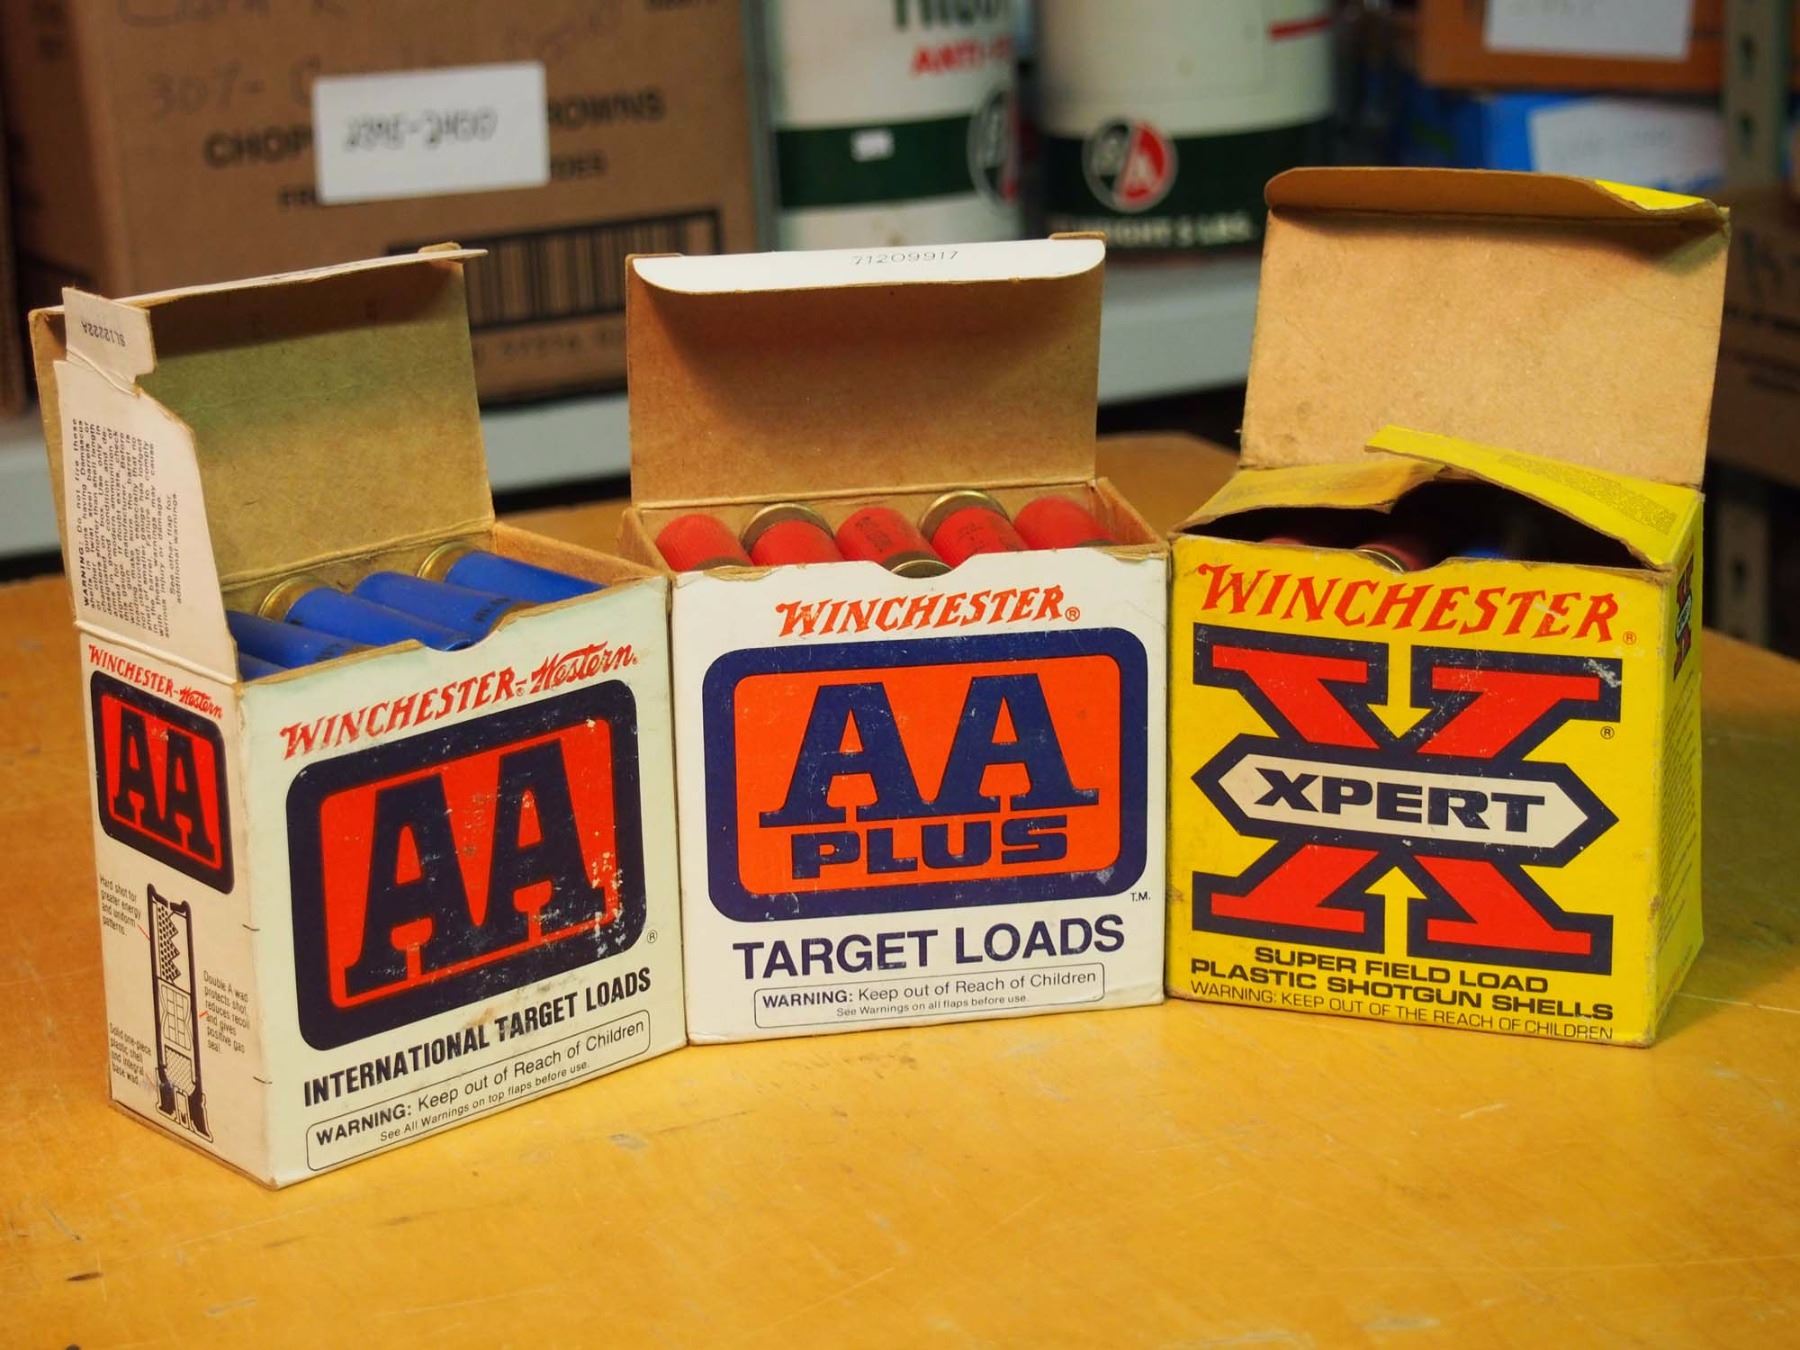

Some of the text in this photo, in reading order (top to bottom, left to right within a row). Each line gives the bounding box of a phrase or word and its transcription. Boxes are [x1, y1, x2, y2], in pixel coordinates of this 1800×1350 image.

[852, 250, 959, 265] 71209917
[775, 584, 1065, 638] WINCHESTER
[1198, 563, 1620, 643] WINCHESTER
[112, 706, 215, 860] AA
[758, 673, 1099, 828] AA
[1254, 767, 1545, 832] XPERT
[344, 737, 608, 999] AA
[791, 815, 1067, 880] PLUS
[732, 914, 1126, 980] TARGET LOADS
[1254, 947, 1548, 993] SUPER FIELD LOAD
[762, 970, 1097, 1009] WARNING: Keep out of Reach of Children
[836, 1006, 857, 1017] See
[859, 1003, 909, 1016] Warnings
[912, 1003, 925, 1011] on
[927, 1000, 941, 1010] all
[943, 998, 969, 1010] flaps
[971, 995, 1005, 1006] before
[1190, 958, 1614, 1021] PLASTIC SHOTGUN SHELLS
[1190, 980, 1614, 1040] WARNING: KEEP OUT OF THE REACH OF CHILDREN
[304, 967, 651, 1106] INTERNATIONAL TARGET LOADS
[316, 1020, 645, 1146] WARNING: Keep out of Reach of Children
[380, 1128, 401, 1143] See
[403, 1122, 419, 1135] All
[420, 1104, 470, 1128] Warnings
[472, 1098, 486, 1109] on
[488, 1089, 505, 1105] top
[507, 1080, 532, 1098] flaps
[535, 1067, 567, 1088] before
